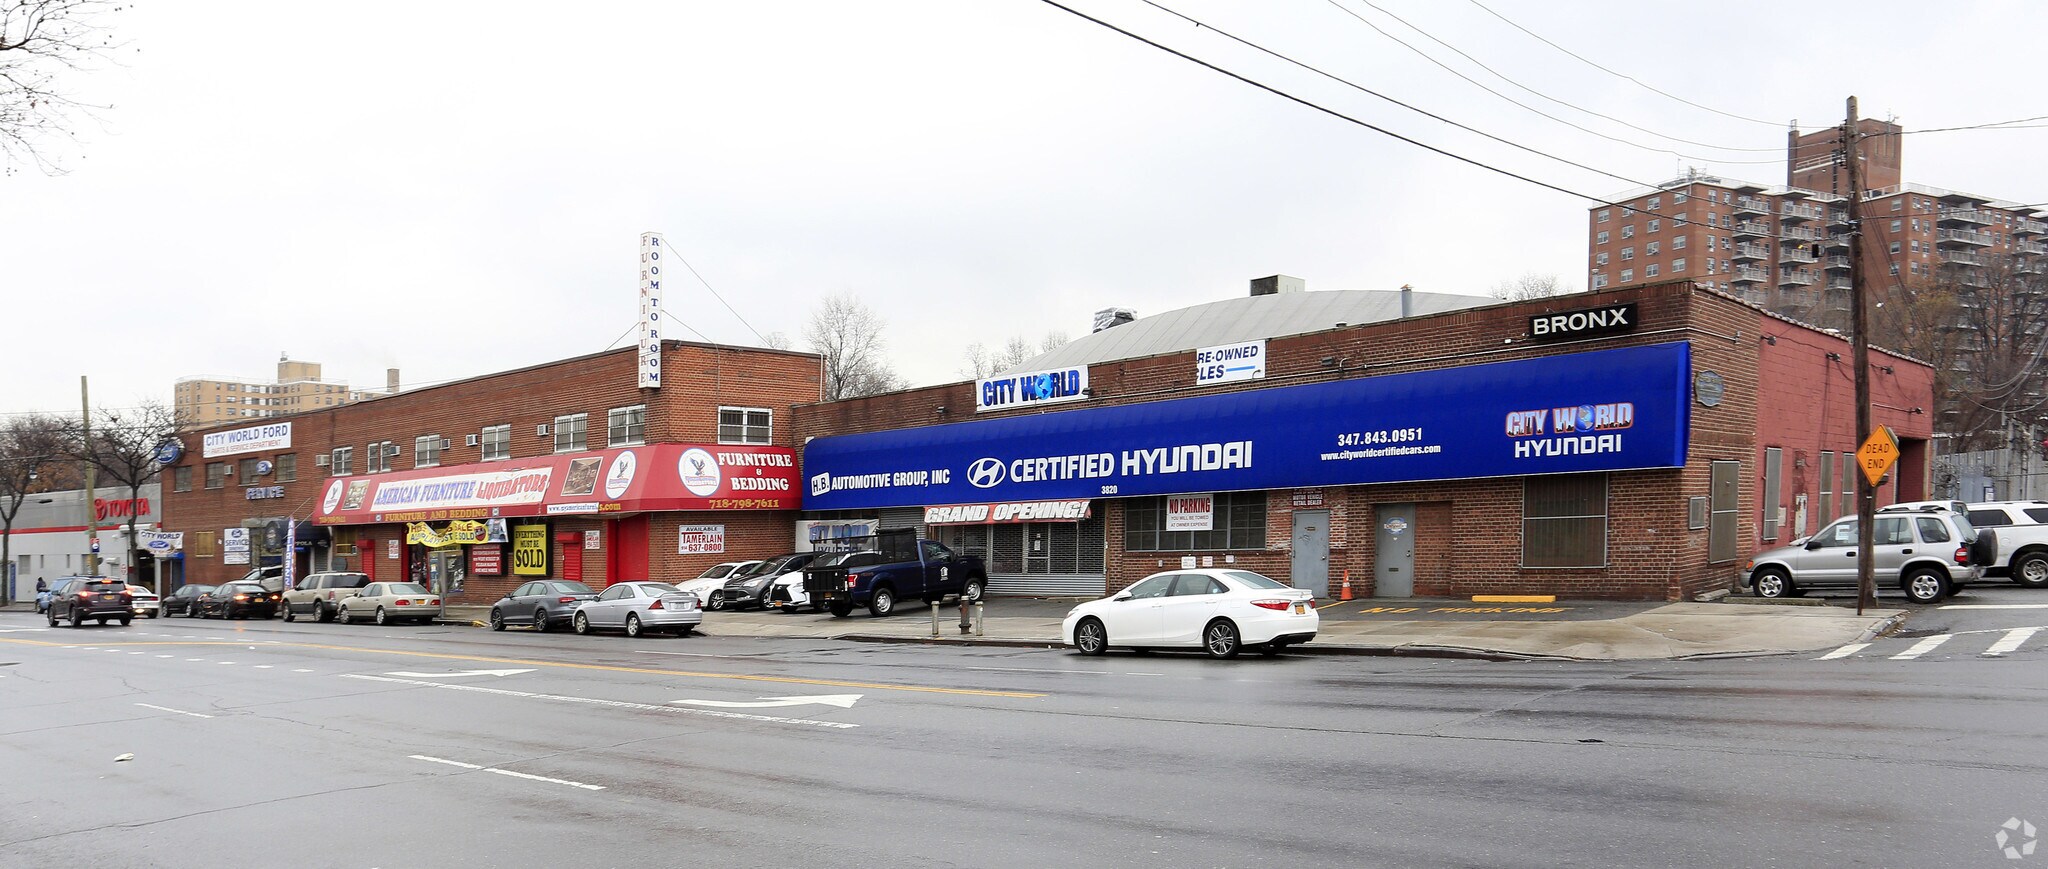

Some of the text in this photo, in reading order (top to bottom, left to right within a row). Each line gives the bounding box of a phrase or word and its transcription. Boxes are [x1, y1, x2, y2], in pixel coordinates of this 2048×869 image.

[640, 236, 648, 383] FURNITURE
[649, 237, 660, 382] ROOM TO ROOM
[1533, 307, 1629, 336] BRONX
[1197, 364, 1225, 380] LES
[982, 378, 1016, 407] CITY
[1506, 402, 1634, 437] CITY WORLD
[206, 425, 288, 447] CITY WORLD FORD
[1337, 427, 1422, 447] 347.843.0951
[230, 443, 249, 453] SERVICE
[250, 439, 281, 449] DEPARTMENT
[1320, 445, 1441, 461] www.cityworldcertifiedcars.com
[1514, 434, 1622, 458] HYUNDAI
[1866, 443, 1890, 454] DEAD
[717, 452, 793, 467] FURNITURE
[1010, 441, 1253, 483] CERTIFIED HYUNDAI
[1868, 459, 1885, 469] END
[756, 468, 762, 476] &
[831, 473, 891, 490] AUTOMOTIVE
[893, 470, 929, 488] GROUP,
[931, 469, 950, 484] INC
[374, 474, 548, 505] AMERICAN FURNITURE LIQUIDATORS
[730, 477, 789, 491] BEDDING
[1101, 485, 1118, 495] 3820
[709, 499, 779, 510] 718-798-7611
[924, 500, 1091, 523] GRAND OPENING!
[1169, 497, 1211, 514] NO PARKING
[385, 508, 488, 521] FURNITURE AND BEDDING
[515, 530, 544, 539] EVERYTHING
[681, 532, 723, 543] TAMERLAIN
[225, 539, 250, 547] SERVICE
[521, 540, 532, 548] MUST
[688, 543, 722, 551] 637-0800
[515, 549, 544, 568] SOLD
